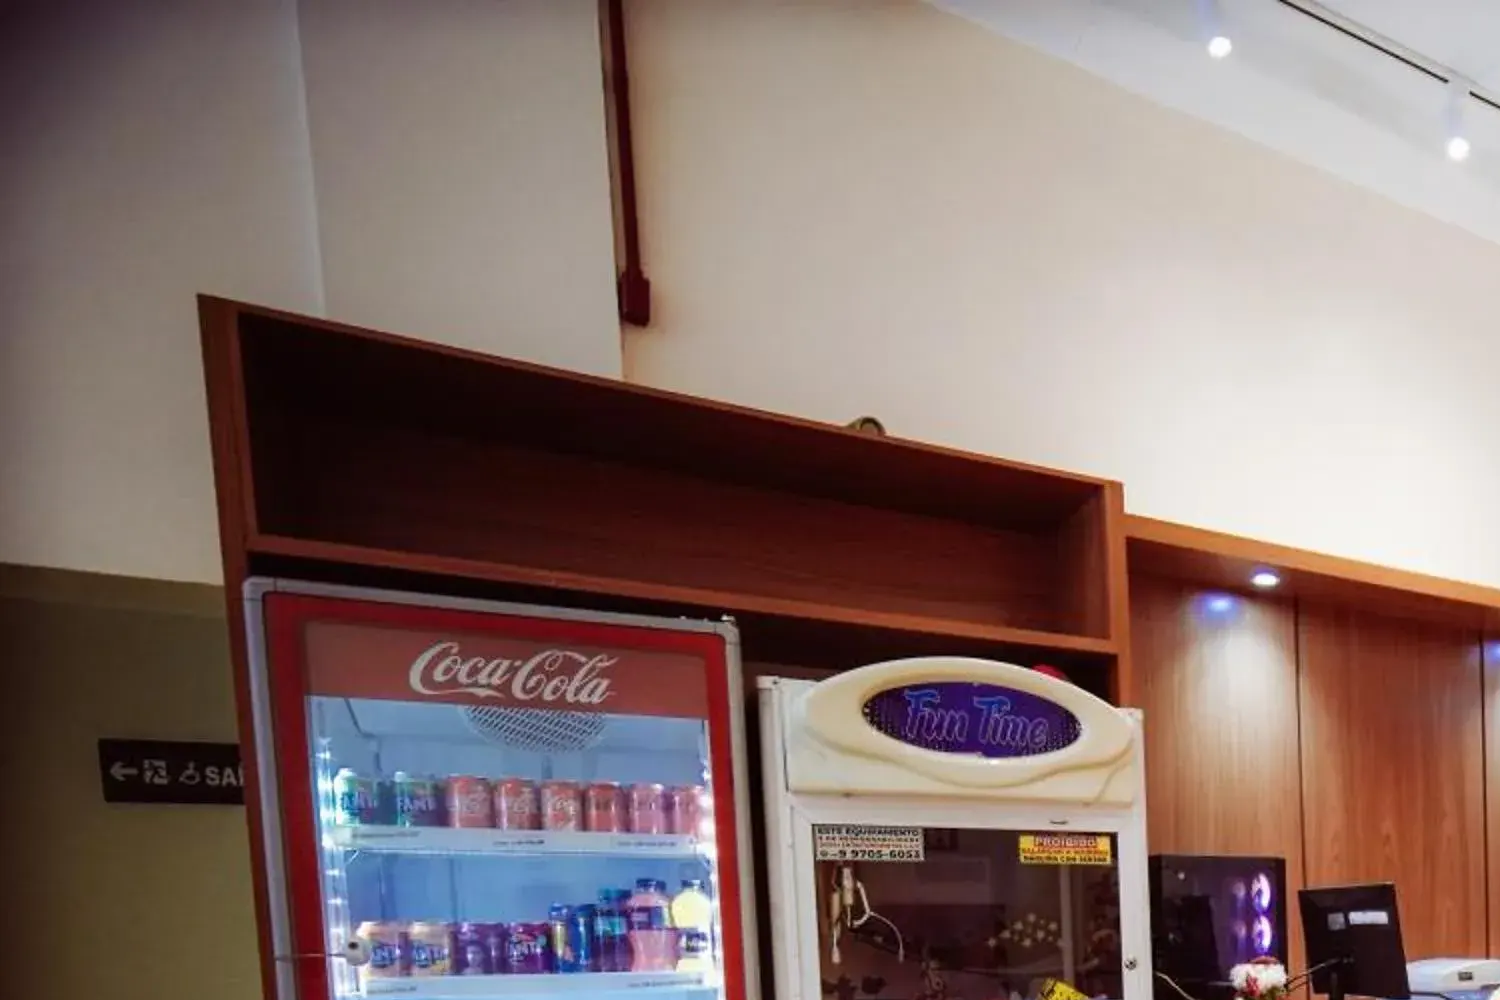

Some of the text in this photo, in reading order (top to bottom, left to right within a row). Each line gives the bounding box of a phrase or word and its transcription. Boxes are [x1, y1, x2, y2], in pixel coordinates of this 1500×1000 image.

[409, 641, 620, 704] Coca-Cola
[903, 688, 1050, 749] Fun Time
